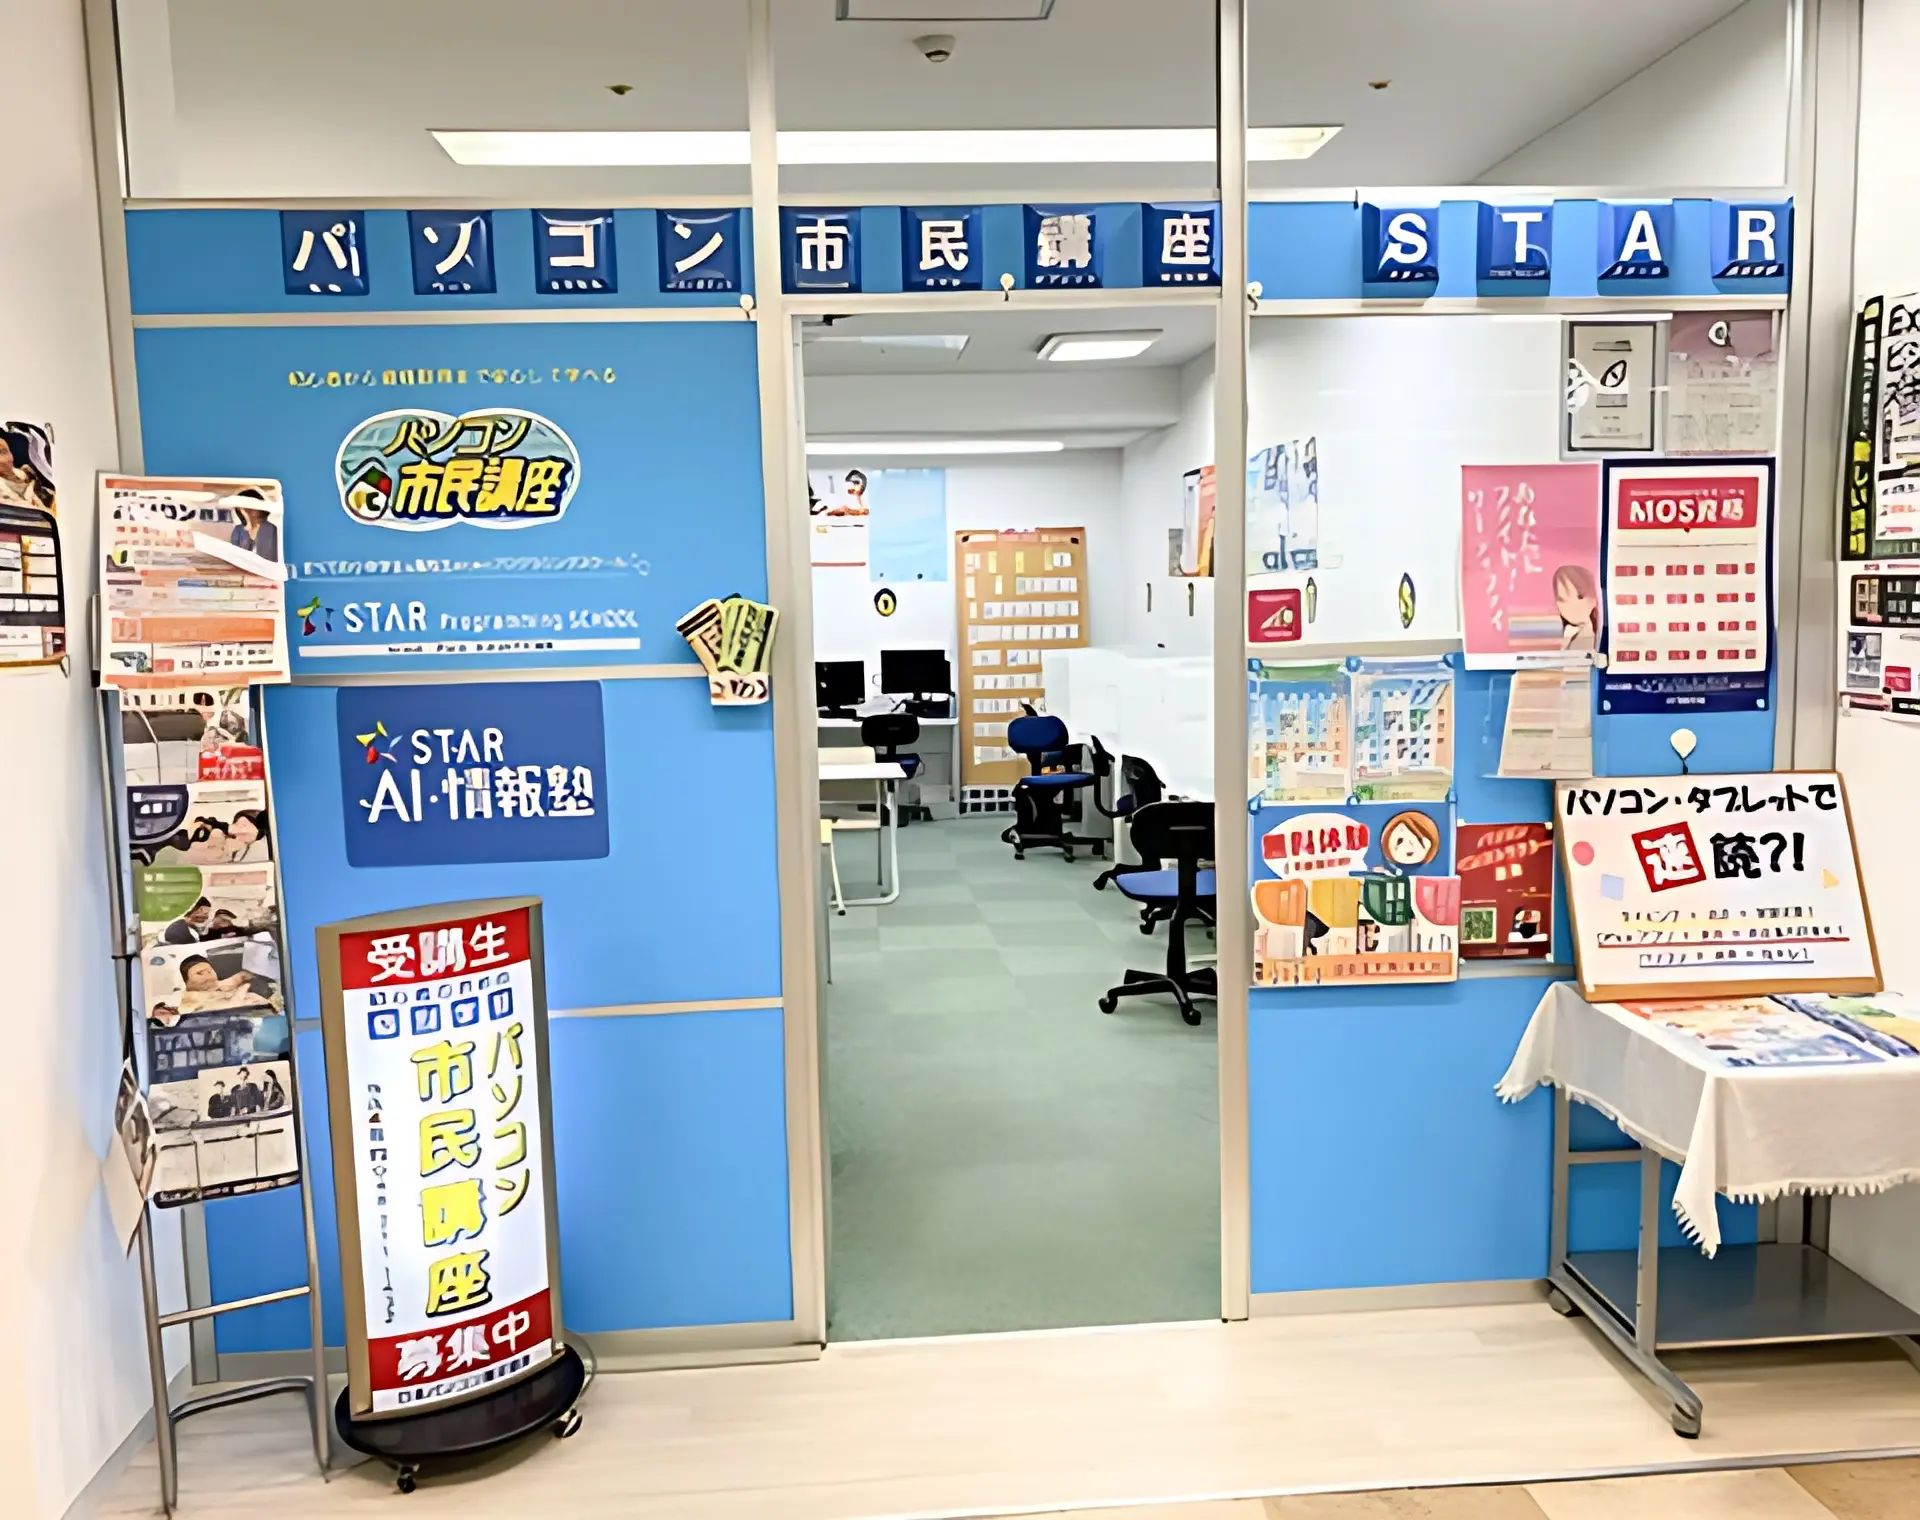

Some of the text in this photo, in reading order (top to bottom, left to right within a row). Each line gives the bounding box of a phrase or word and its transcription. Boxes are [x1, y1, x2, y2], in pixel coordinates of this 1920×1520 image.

[1386, 210, 1777, 264] STAR
[343, 600, 427, 634] STAR
[411, 728, 504, 764] STAR
[367, 921, 510, 983] 受生
[488, 1022, 530, 1217] パソコン
[410, 1040, 493, 1318] 市民座
